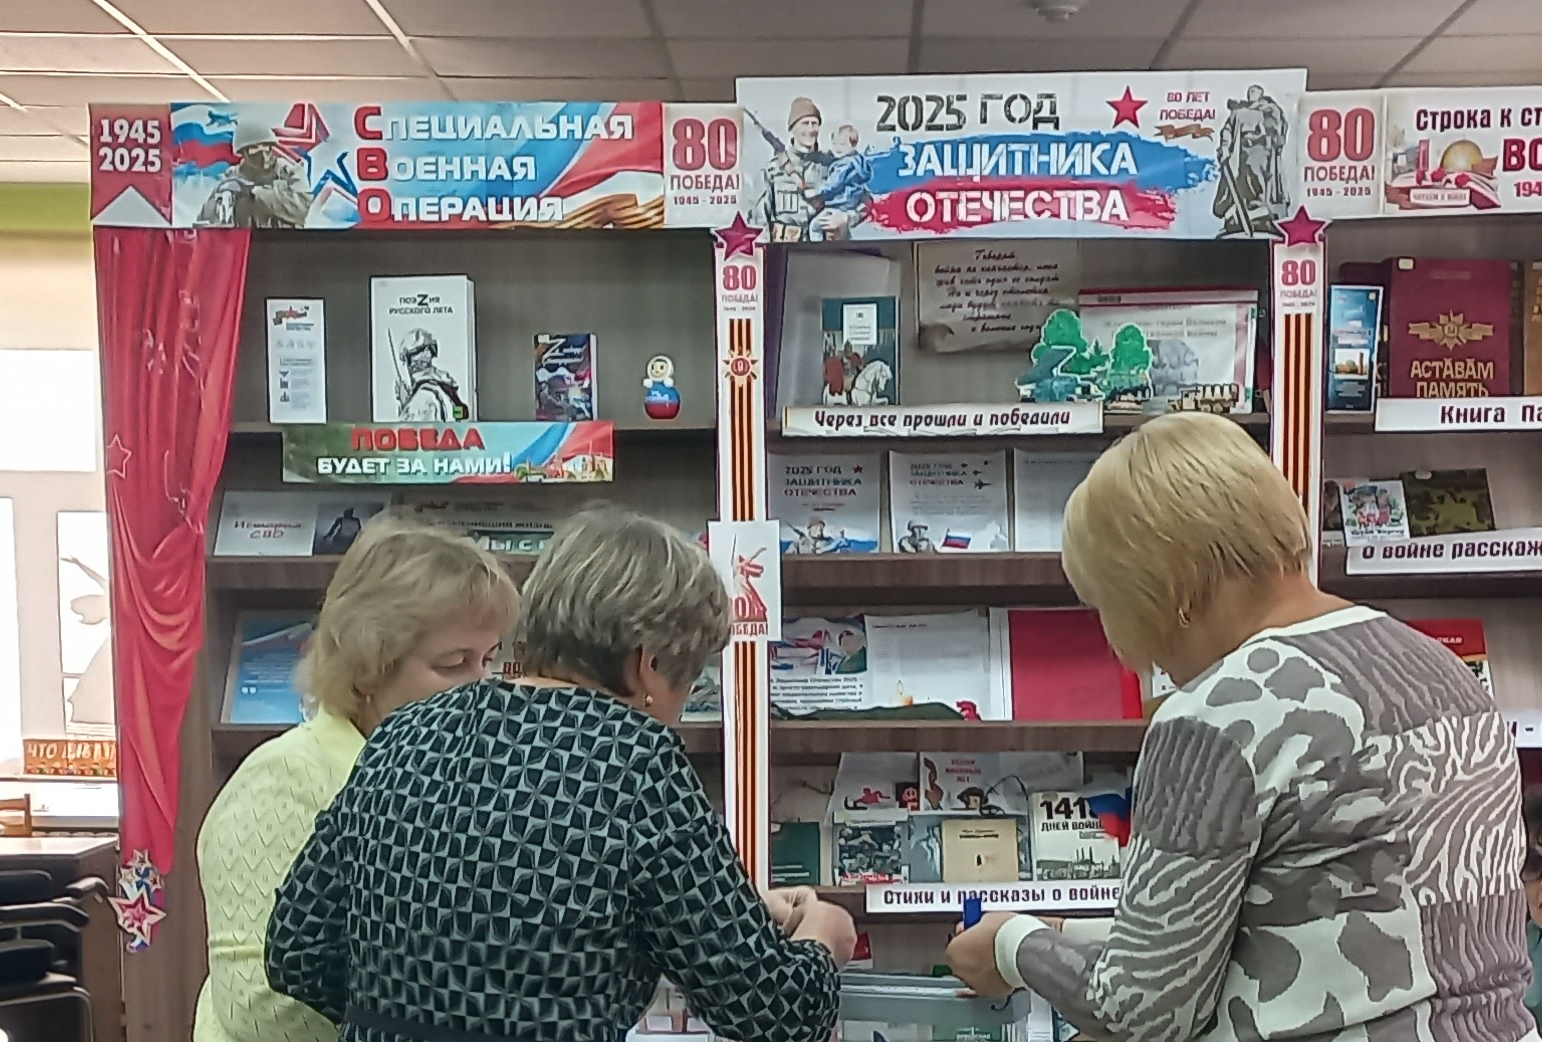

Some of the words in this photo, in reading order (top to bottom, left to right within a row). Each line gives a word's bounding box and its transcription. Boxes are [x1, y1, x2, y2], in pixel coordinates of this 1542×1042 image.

[1184, 91, 1210, 104] ЛЕТ
[354, 106, 634, 142] СПЕЦИАЛЬНАЯ
[877, 95, 968, 132] 2025
[979, 93, 1061, 131] ГОД
[1159, 108, 1216, 121] ПОБЕДА!
[1415, 108, 1492, 132] Строка
[1500, 107, 1513, 128] к
[99, 118, 162, 144] 1945
[1307, 108, 1376, 162] 80
[672, 117, 738, 173] 80
[98, 149, 162, 174] 2025
[358, 147, 537, 183] ВОЕННАЯ
[898, 141, 1139, 181] ЗАЩИТНИКА
[1304, 164, 1376, 183] ПОБЕДА!
[670, 173, 740, 193] ПОБЕДА!
[359, 187, 565, 223] ОПЕРАЦИЯ
[906, 188, 1130, 224] ОТЕЧЕСТВА
[722, 264, 757, 291] 80
[1281, 259, 1316, 286] 80
[815, 409, 863, 430] Через
[869, 411, 897, 428] все
[903, 410, 967, 430] прошли
[973, 410, 984, 427] и
[989, 409, 1071, 428] победили
[1440, 403, 1506, 425] Книга
[350, 428, 486, 452] ПОБЕДА
[316, 456, 391, 477] БУДЕТ
[396, 457, 429, 476] ЗА
[434, 452, 512, 476] НАМИ!
[816, 465, 842, 475] ГОД
[1382, 542, 1444, 560] войне
[731, 622, 769, 637] ОБЕДА!
[28, 743, 58, 760] ЧТО
[1039, 796, 1101, 821] 141
[884, 888, 934, 906] Стихи
[941, 890, 950, 904] и
[957, 887, 1046, 906] рассказы
[1053, 887, 1062, 901] о
[1069, 885, 1121, 902] войне
